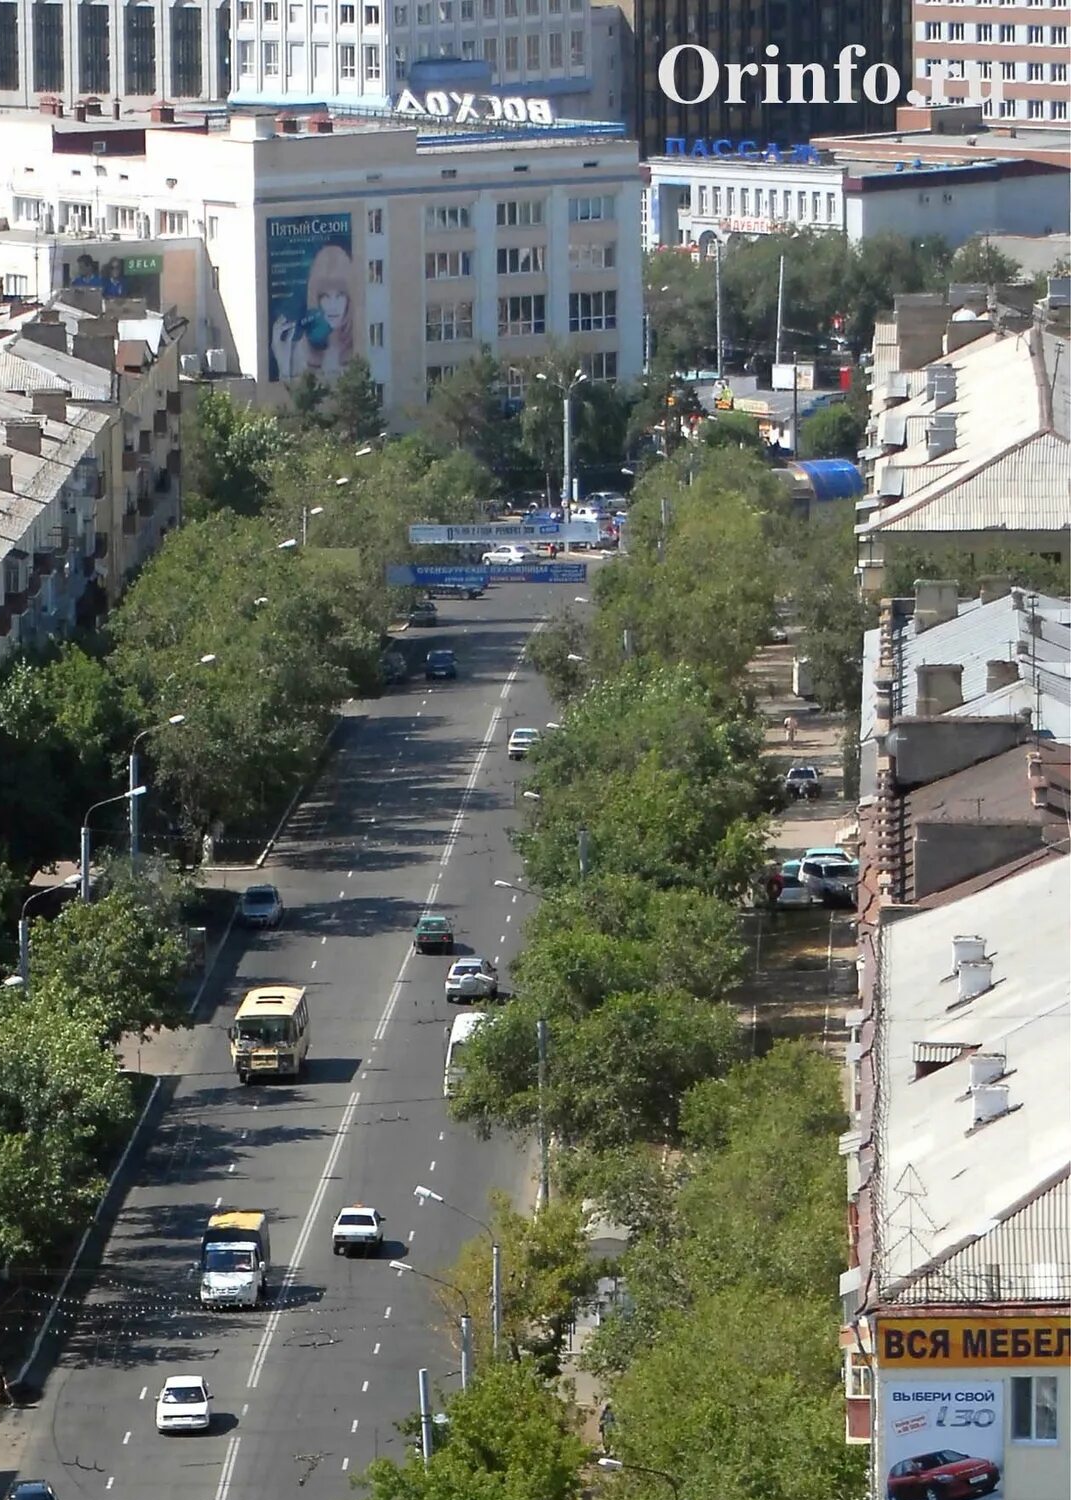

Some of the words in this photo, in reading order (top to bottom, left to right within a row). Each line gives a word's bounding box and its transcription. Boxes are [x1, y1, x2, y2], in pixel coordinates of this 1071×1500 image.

[664, 137, 820, 165] ПАССАЖ
[271, 220, 311, 237] Пятый
[311, 218, 349, 235] Сезон
[128, 259, 157, 269] SELA
[884, 1328, 950, 1359] ВСЯ
[892, 1391, 951, 1402] ВЫБЕРИ
[954, 1389, 995, 1402] СВОЙ
